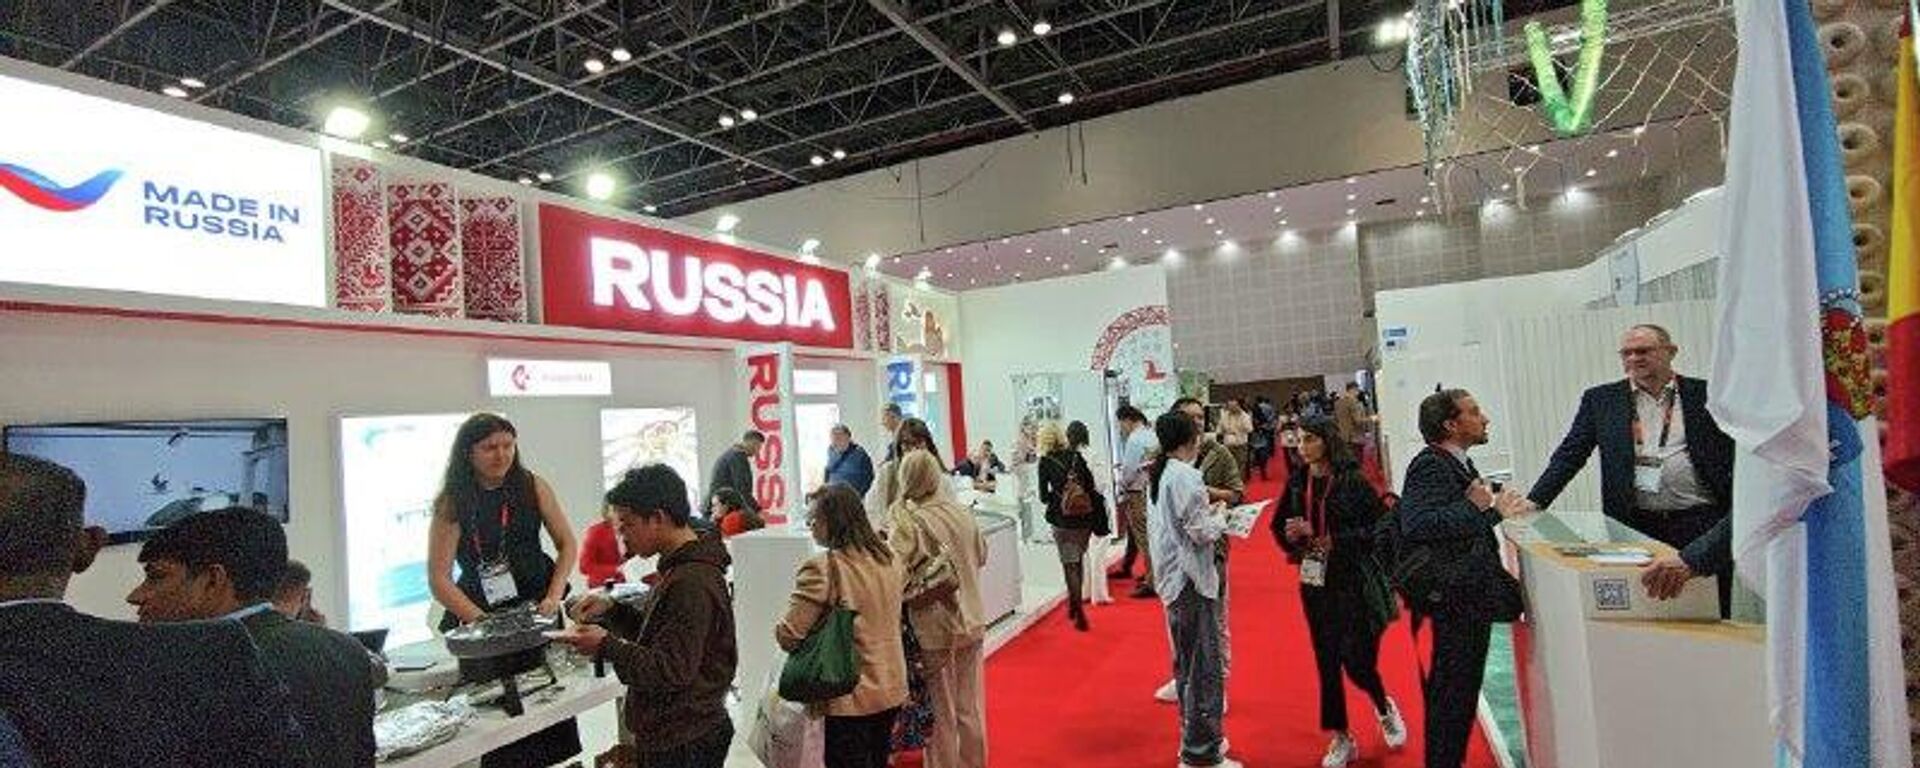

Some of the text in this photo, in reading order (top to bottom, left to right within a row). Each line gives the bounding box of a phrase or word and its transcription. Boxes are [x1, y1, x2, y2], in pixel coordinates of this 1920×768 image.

[144, 180, 300, 224] MADE IN
[144, 205, 285, 243] RUSSIA
[590, 237, 836, 332] RUSSIA
[747, 354, 787, 524] RUSSI
